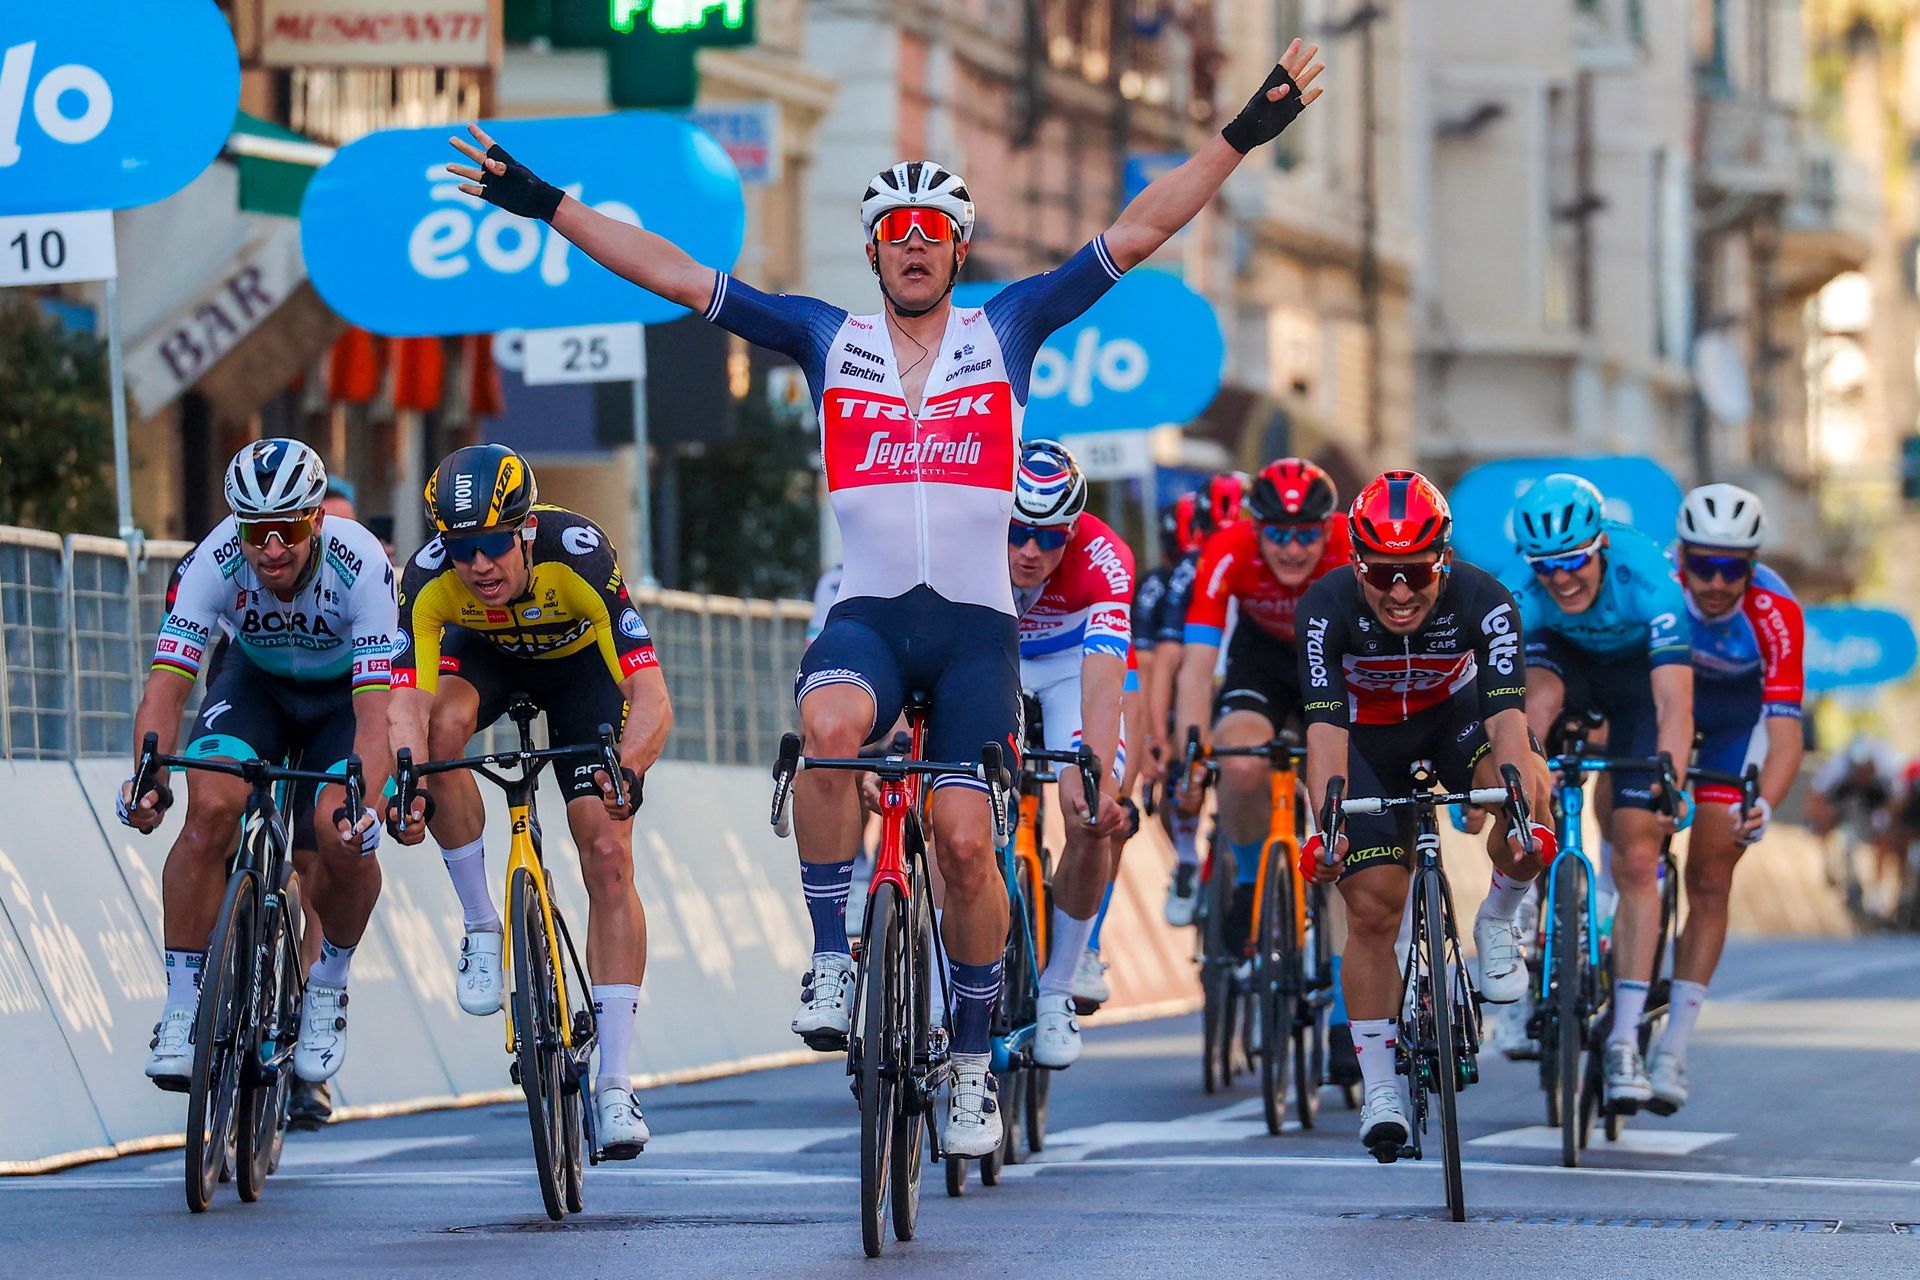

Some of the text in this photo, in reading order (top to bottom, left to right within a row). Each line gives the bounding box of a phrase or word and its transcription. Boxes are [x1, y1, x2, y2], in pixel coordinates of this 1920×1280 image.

[11, 229, 66, 270] 10
[409, 183, 645, 286] eol
[157, 263, 274, 382] BAR
[561, 337, 610, 370] 25
[844, 342, 886, 366] SRAM
[945, 358, 992, 382] ONTRAGER
[839, 360, 885, 384] Santini
[836, 393, 994, 421] TREK
[855, 431, 982, 472] Segafredo
[455, 473, 473, 512] WOUT
[452, 520, 478, 529] LAZER
[213, 535, 241, 566] BOR
[328, 536, 363, 577] BORA
[1084, 535, 1132, 595] Alpecin
[168, 614, 209, 638] BORA
[240, 609, 337, 637] BORA
[1306, 616, 1329, 687] SOUDAL
